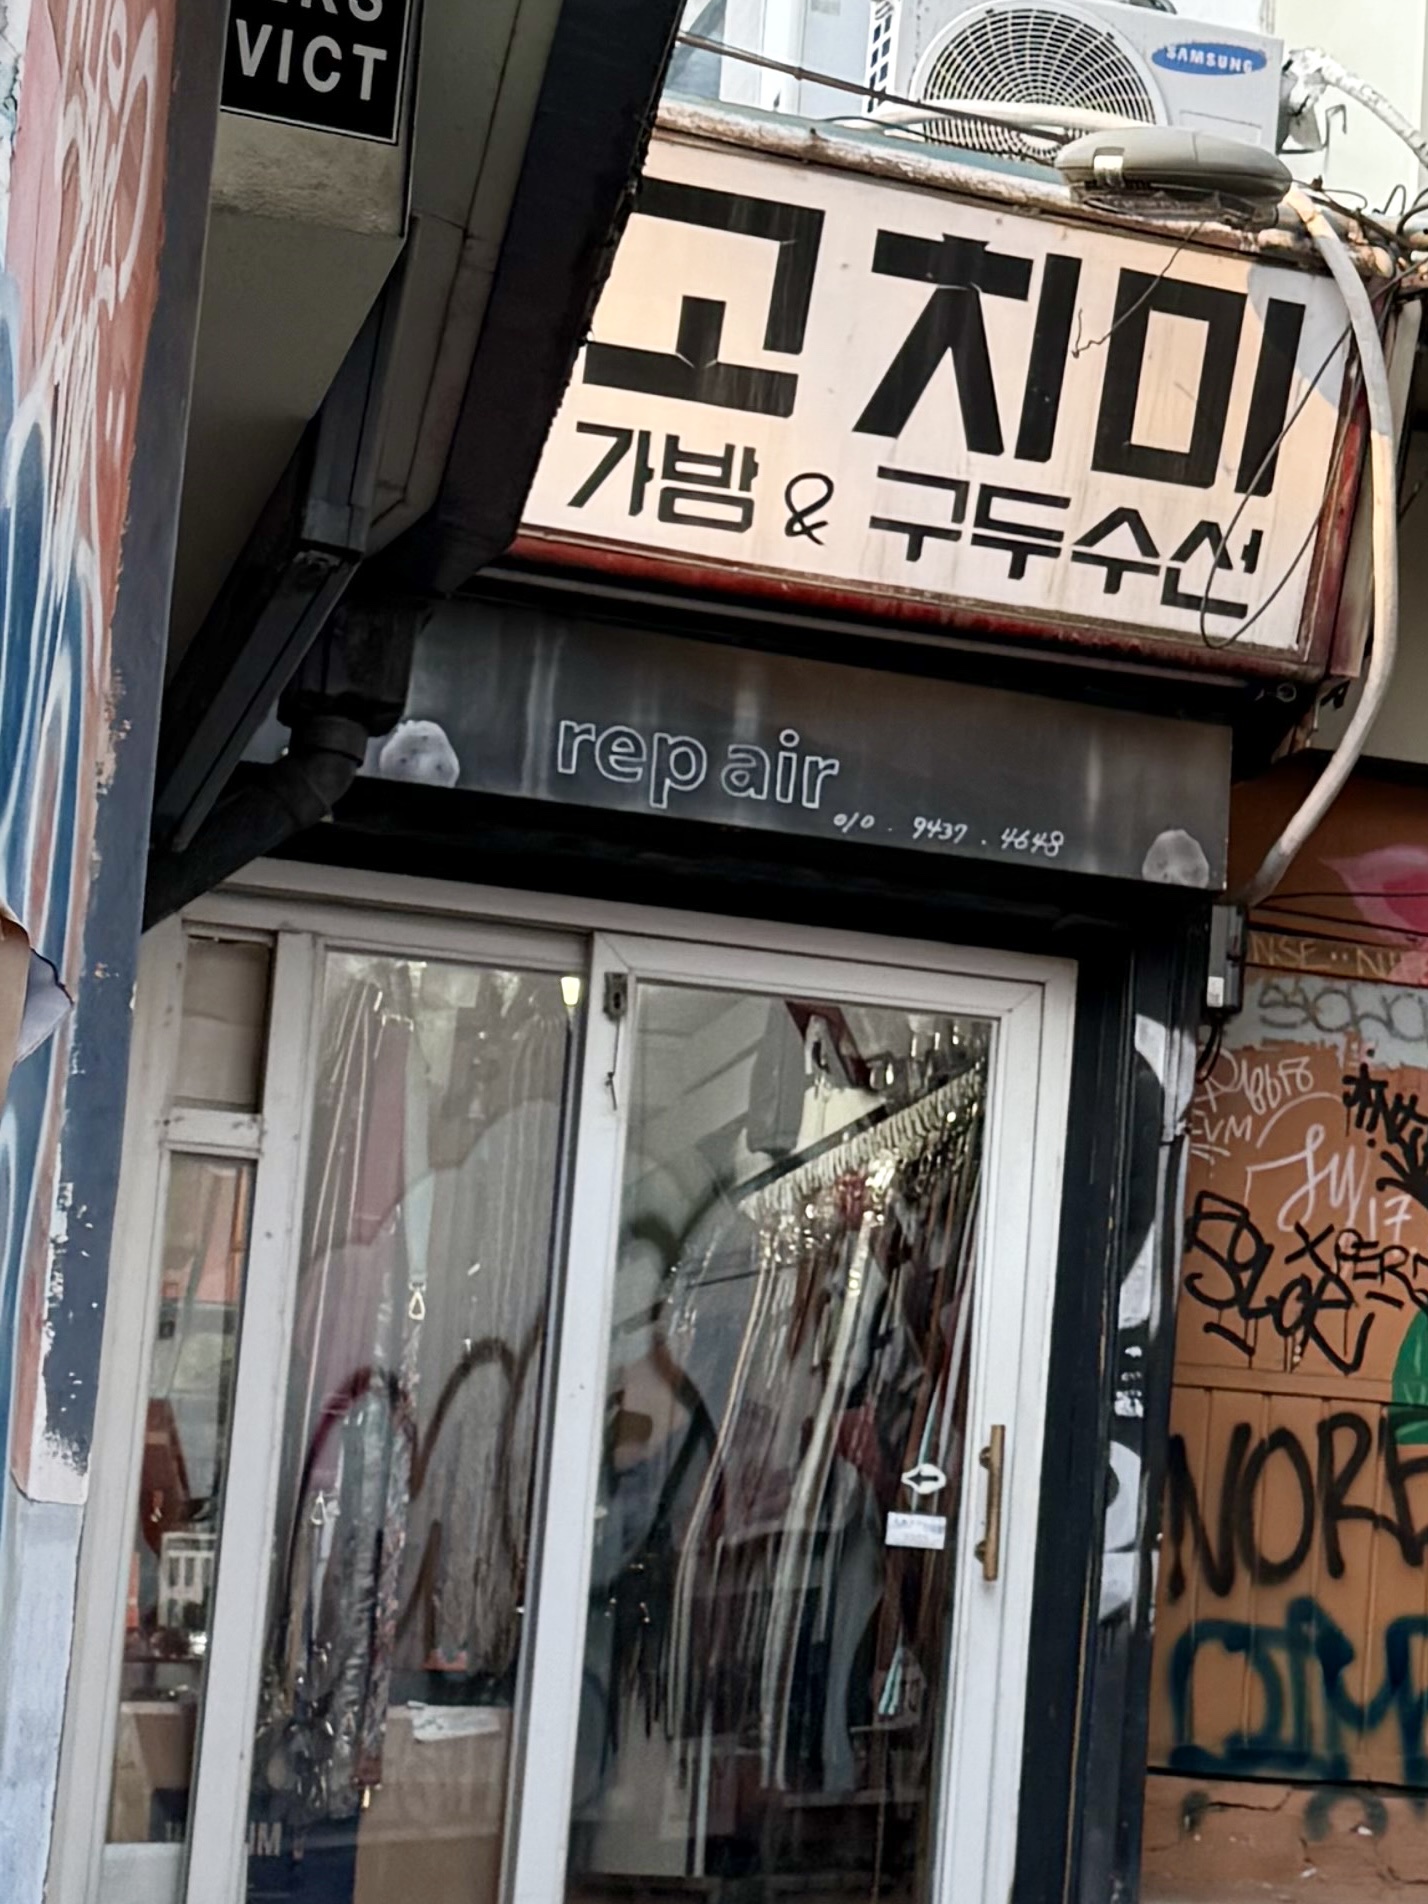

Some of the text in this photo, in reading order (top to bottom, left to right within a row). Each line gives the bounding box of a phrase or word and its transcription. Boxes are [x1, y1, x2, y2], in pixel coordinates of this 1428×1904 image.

[1166, 45, 1253, 74] SAMSUNG
[784, 472, 835, 546] &
[867, 466, 1264, 618] 구두수선
[912, 815, 968, 844] 9437
[1000, 828, 1065, 857] 4648
